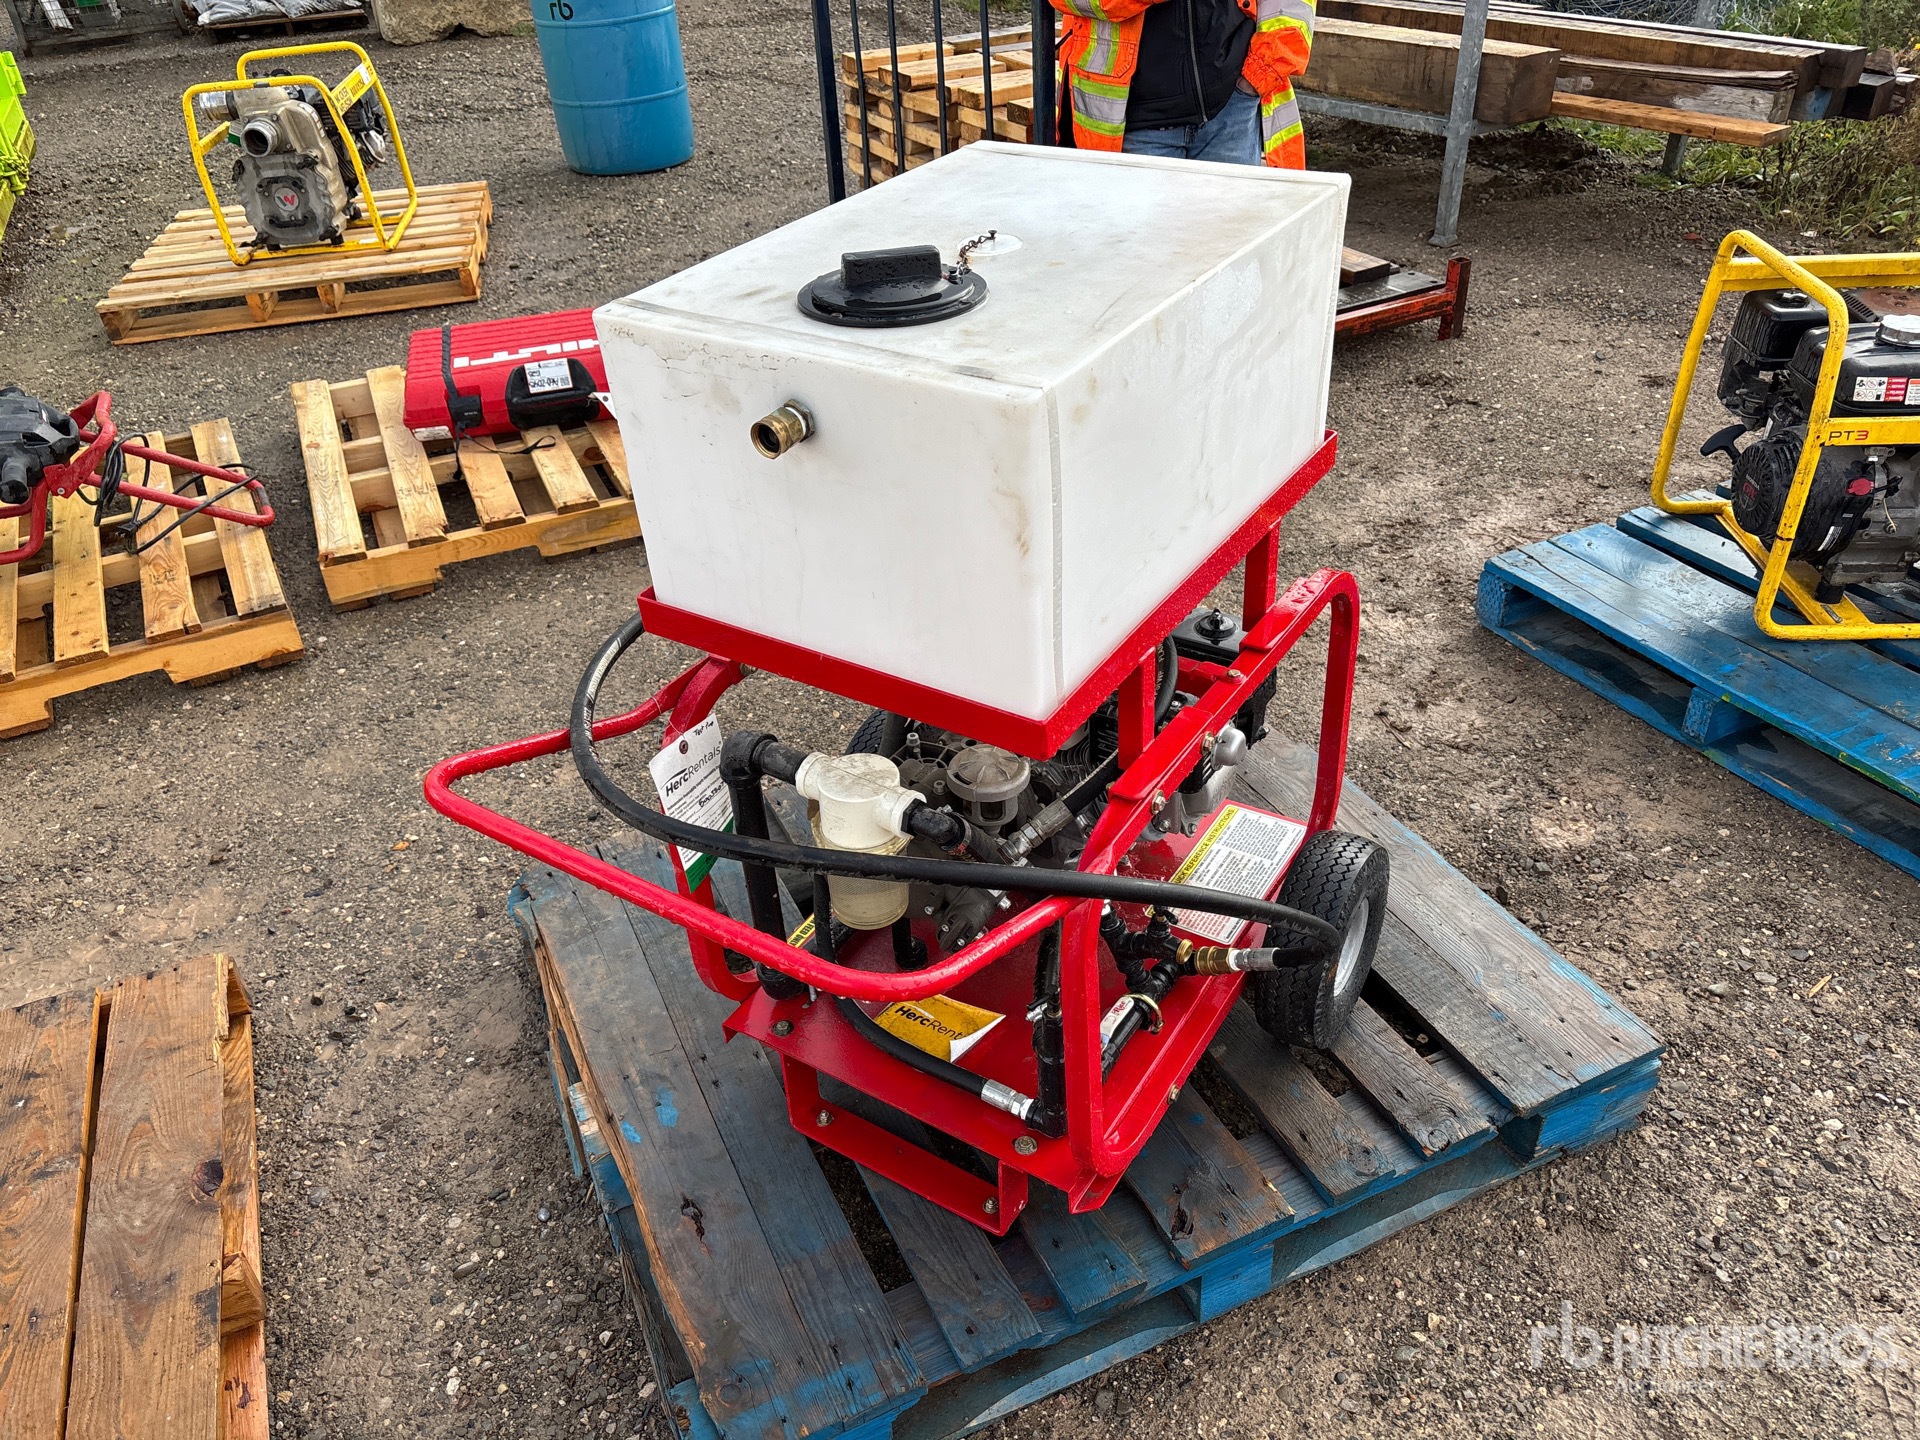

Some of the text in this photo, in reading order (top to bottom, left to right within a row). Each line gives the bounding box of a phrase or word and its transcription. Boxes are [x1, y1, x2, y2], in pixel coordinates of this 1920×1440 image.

[549, 0, 574, 21] rb
[453, 338, 599, 368] HILTI
[1828, 429, 1869, 442] PT3
[1184, 841, 1210, 873] REFERENCE
[894, 1005, 966, 1041] HercRent
